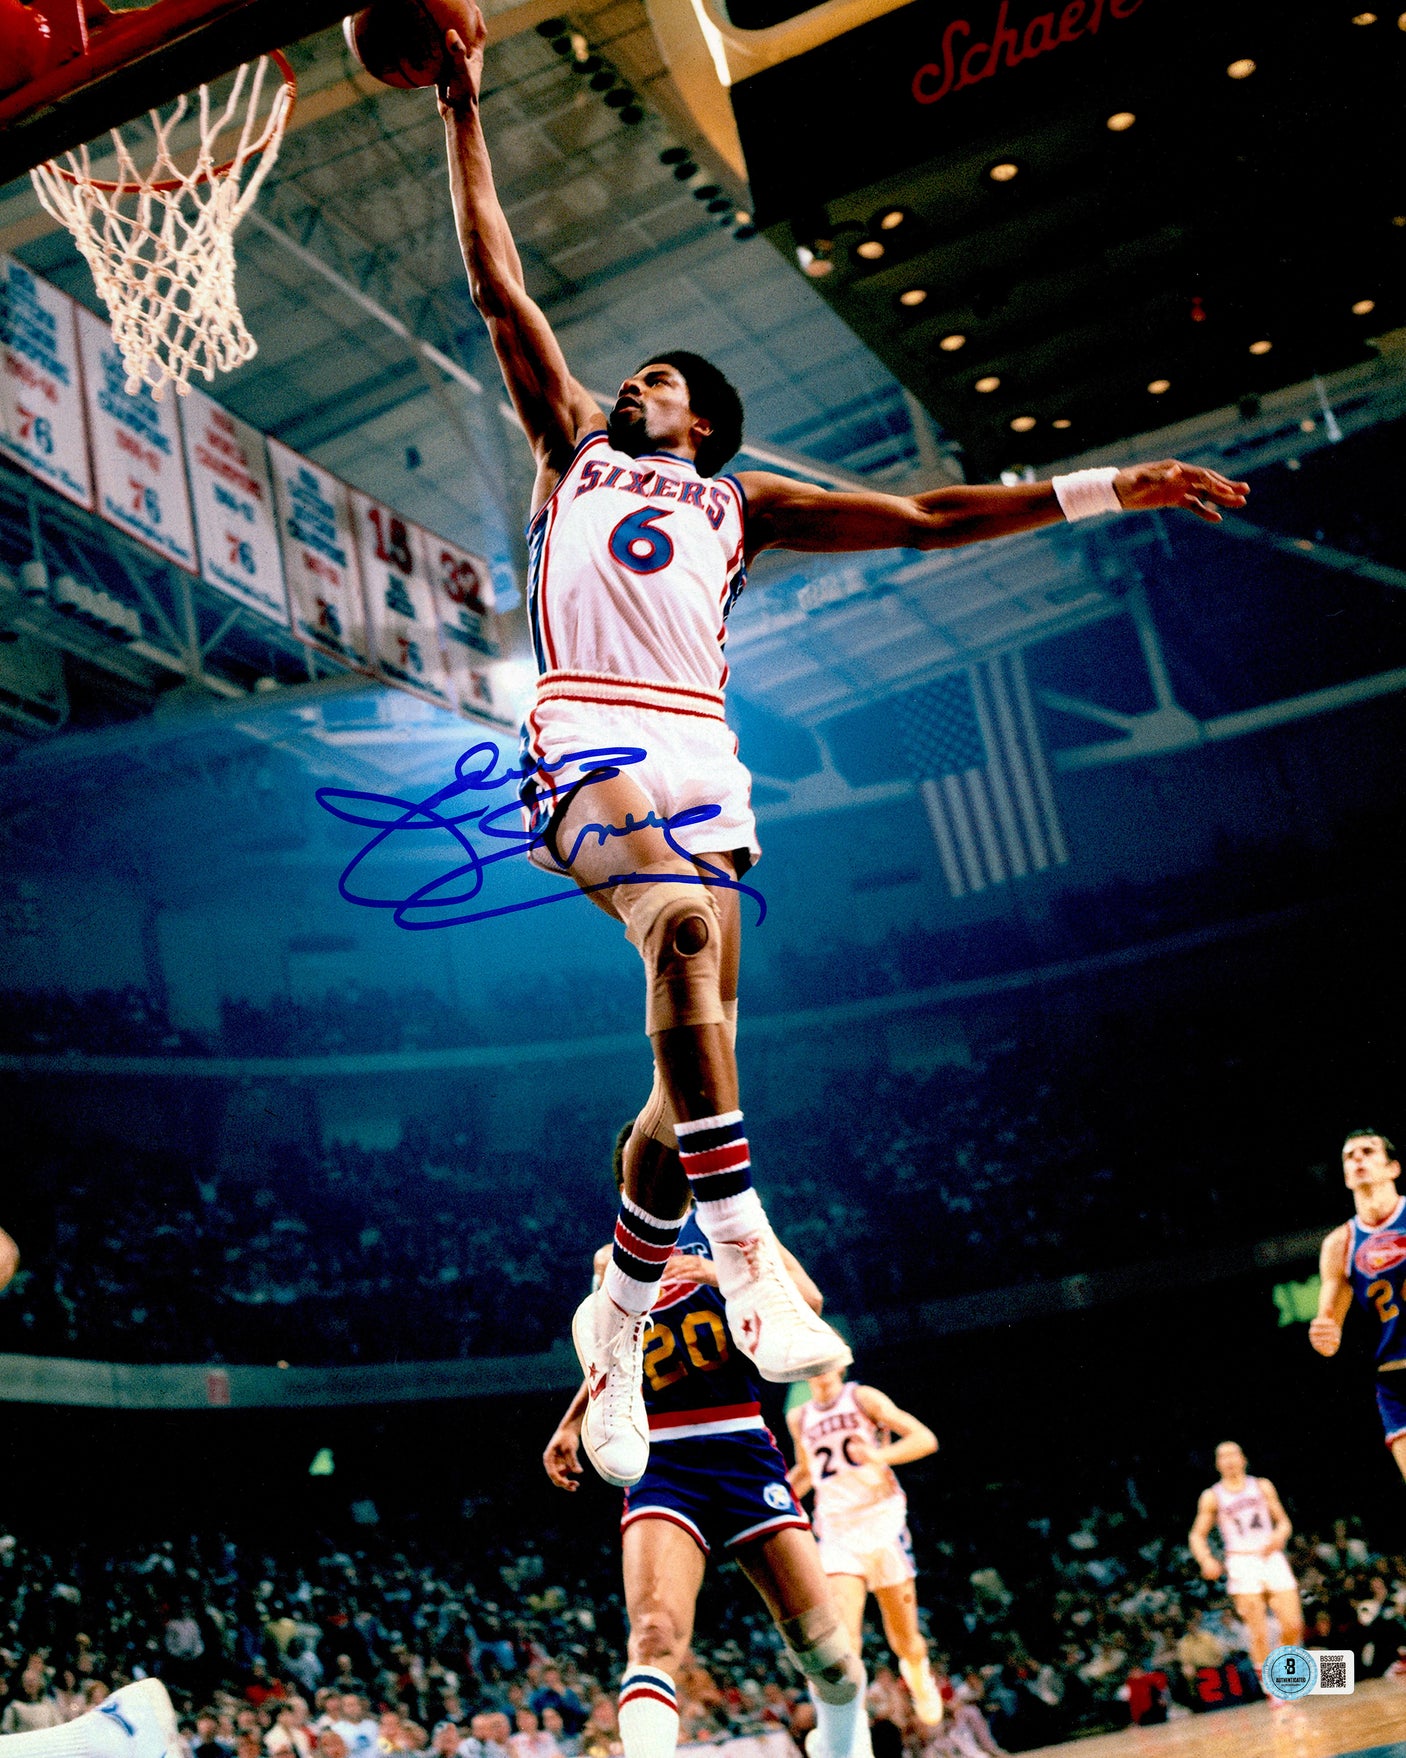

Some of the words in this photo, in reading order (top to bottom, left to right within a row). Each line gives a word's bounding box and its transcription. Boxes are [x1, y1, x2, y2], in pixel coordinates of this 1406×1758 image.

[575, 459, 732, 531] SIXERS
[608, 505, 674, 575] 6
[1367, 1279, 1406, 1323] 2
[642, 1310, 729, 1392] 20
